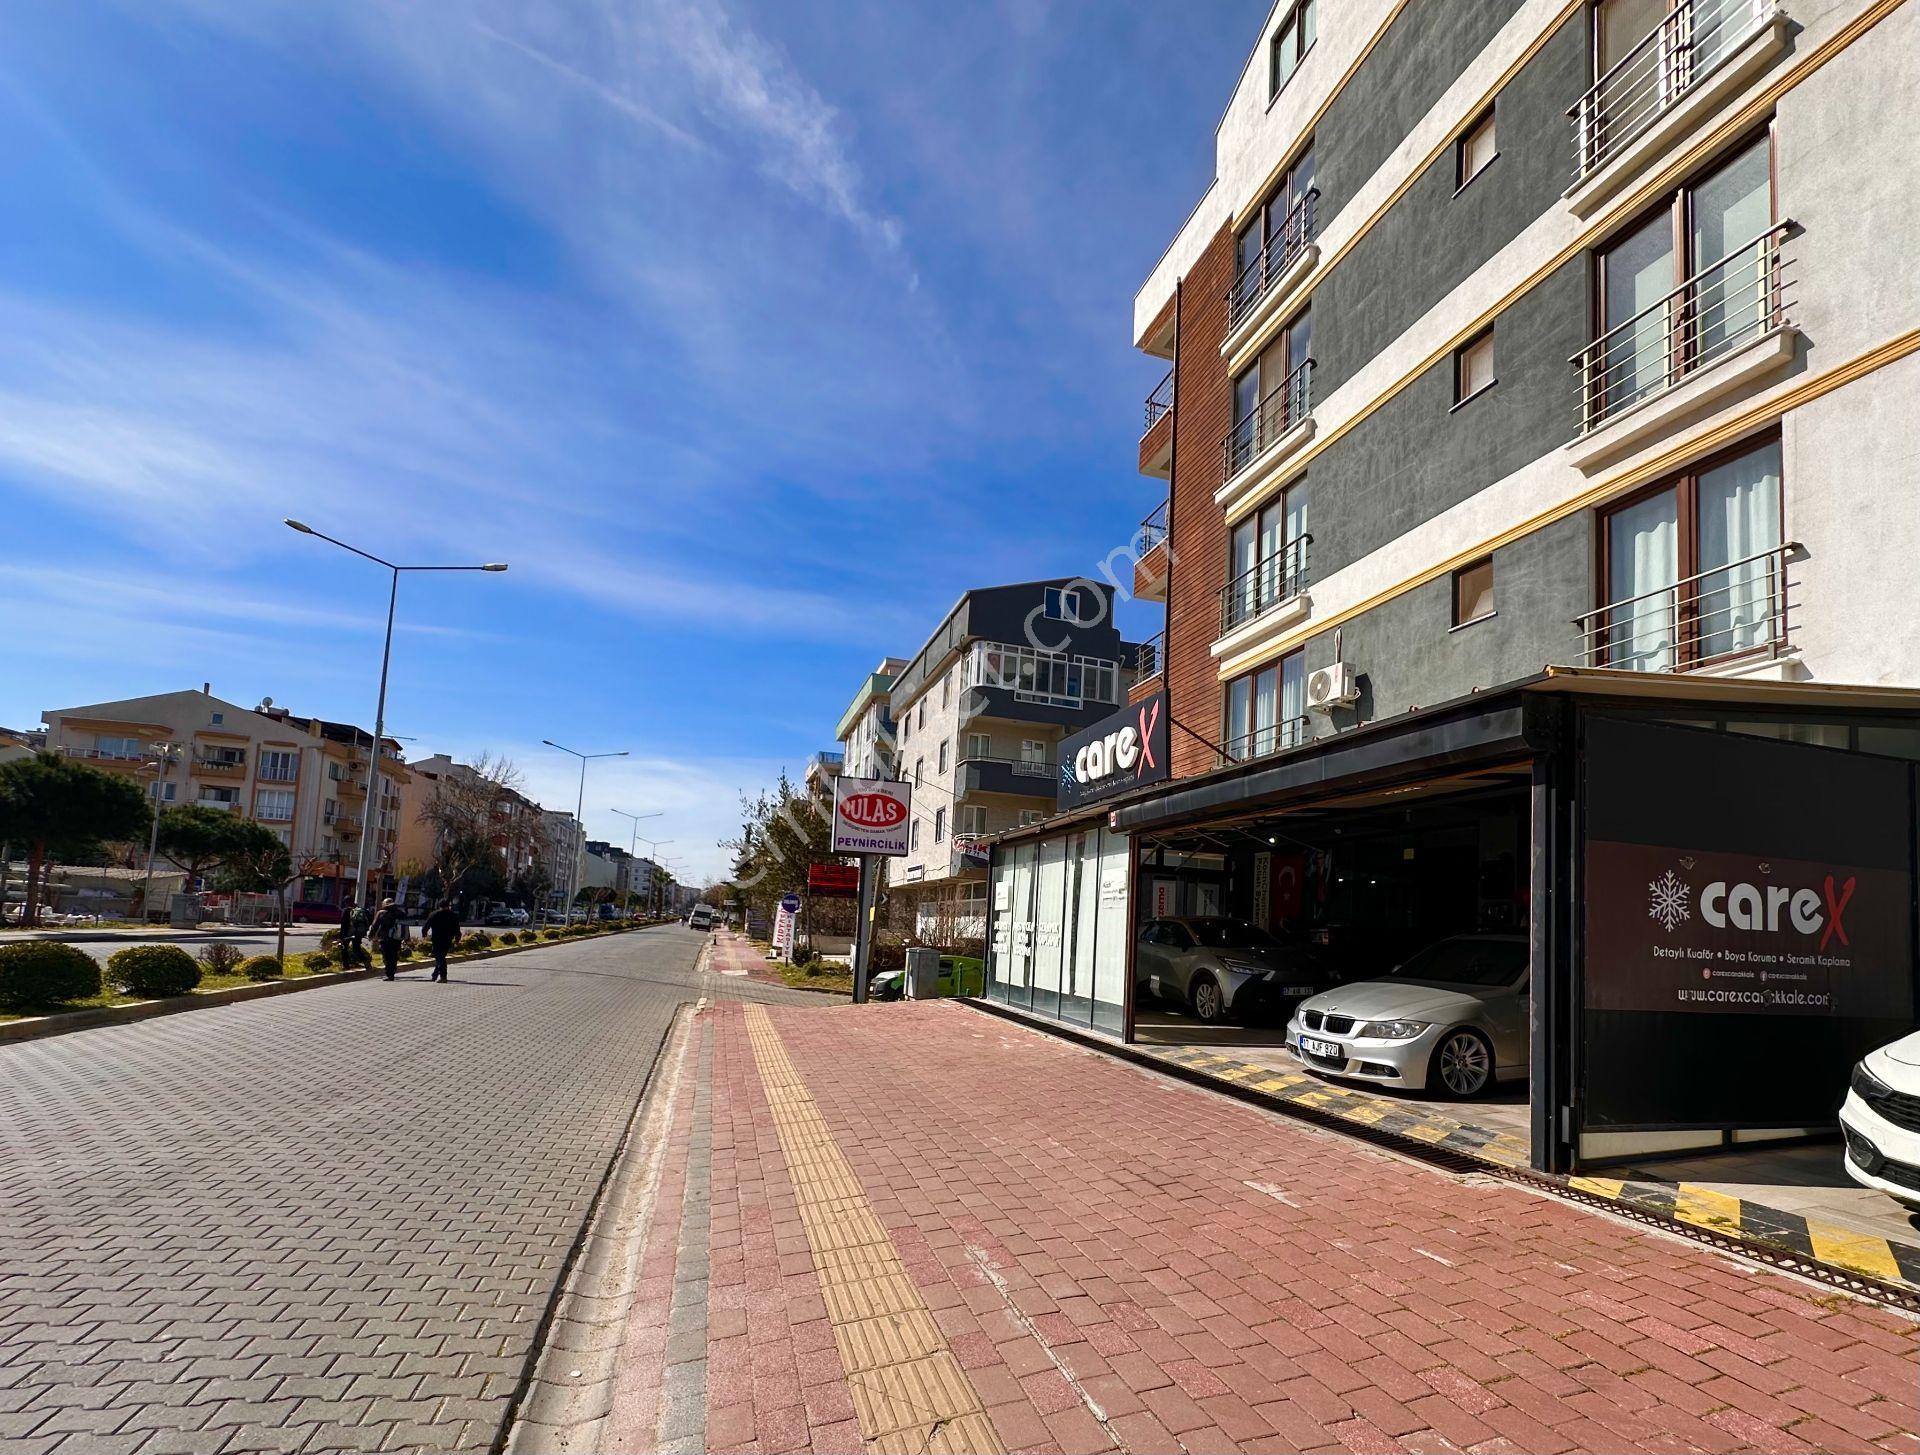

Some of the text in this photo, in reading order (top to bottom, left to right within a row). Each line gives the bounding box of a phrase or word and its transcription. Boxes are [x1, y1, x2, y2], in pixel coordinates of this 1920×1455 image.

[837, 836, 906, 851] PEYNİRCİLİK
[1653, 945, 1851, 967] Detaylı Kuaför Boya Koruma Seramik Kaplama
